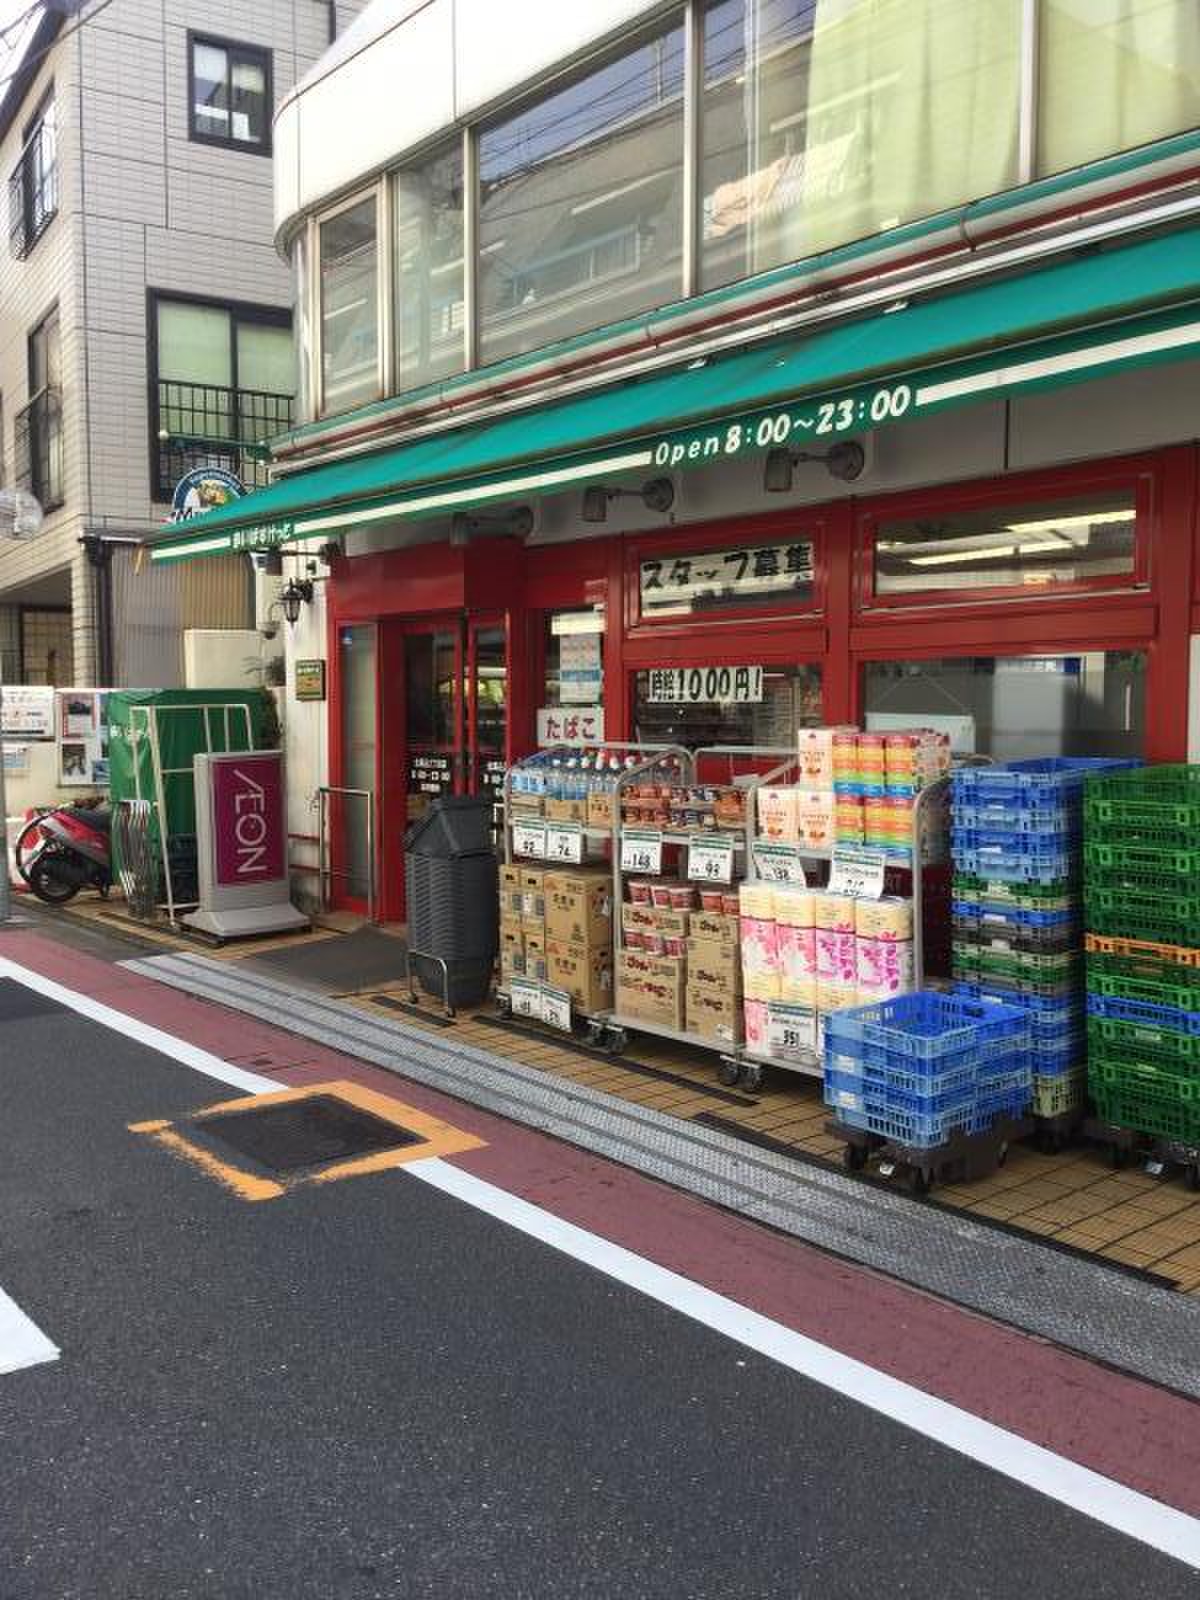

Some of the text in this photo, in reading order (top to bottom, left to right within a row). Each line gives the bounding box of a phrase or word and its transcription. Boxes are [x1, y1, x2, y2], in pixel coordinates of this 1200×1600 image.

[655, 436, 719, 466] Open
[642, 545, 812, 589] スタッフ募集
[546, 714, 595, 739] たばこ
